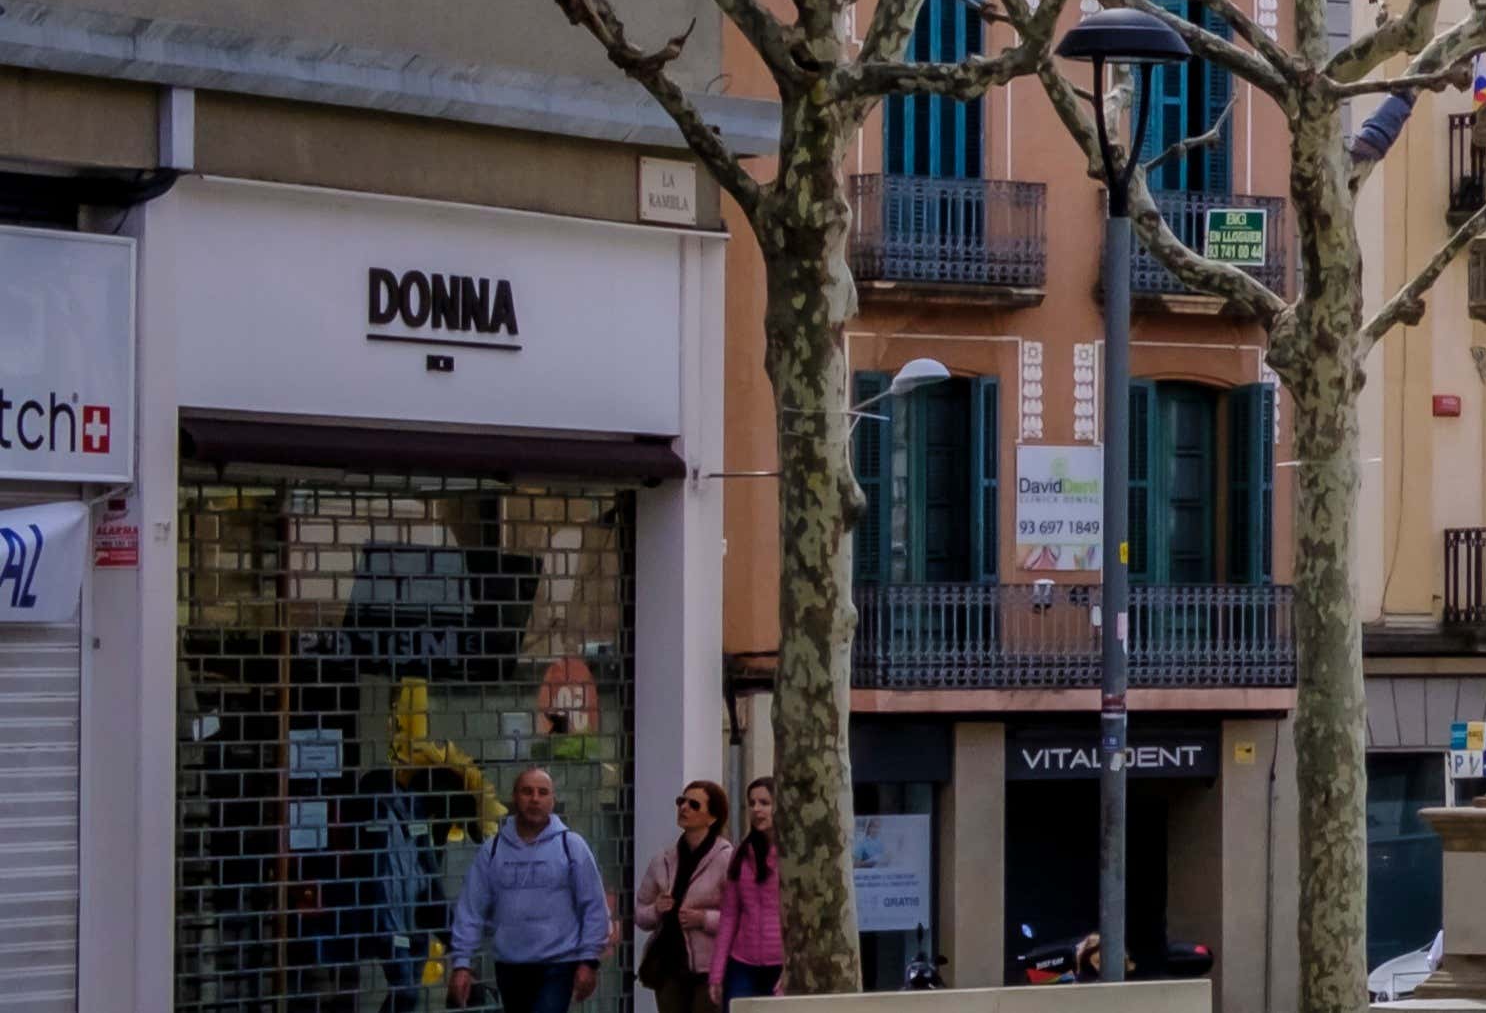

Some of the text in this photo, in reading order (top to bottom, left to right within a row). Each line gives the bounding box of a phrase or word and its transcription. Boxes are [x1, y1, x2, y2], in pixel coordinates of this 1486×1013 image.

[661, 170, 679, 189] LA
[648, 192, 690, 212] RAMBLA
[368, 266, 519, 336] DONNA
[1019, 520, 1100, 534] 93 697 1849
